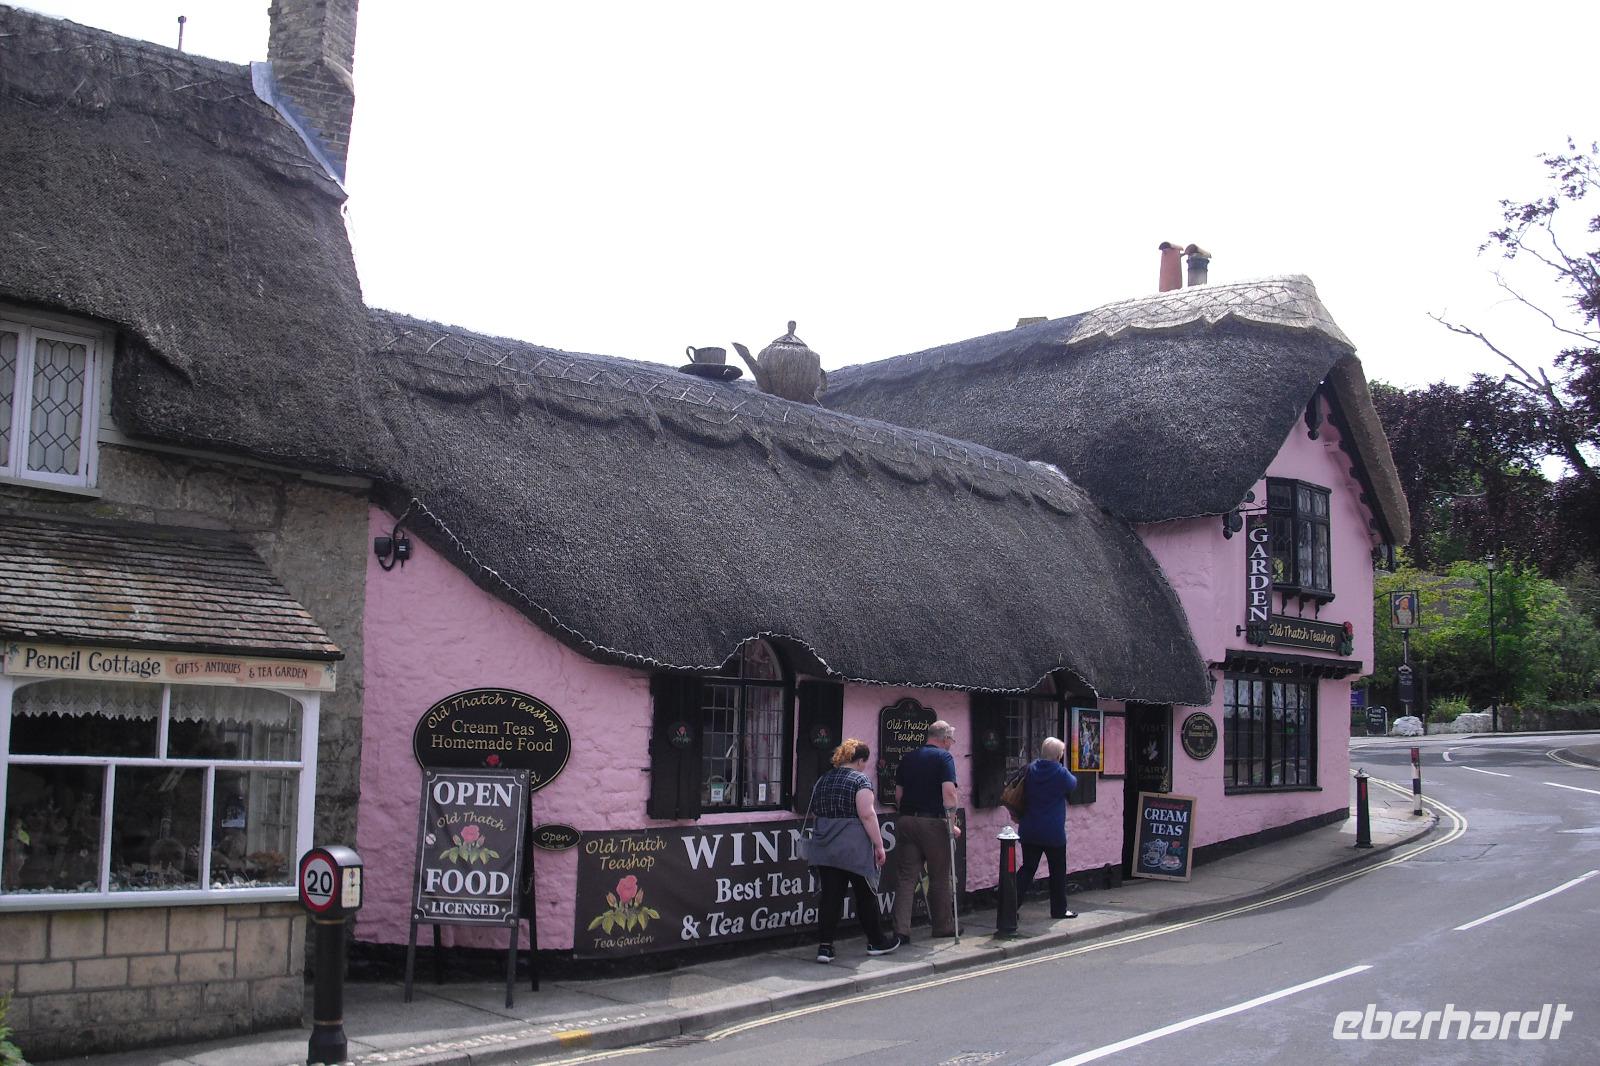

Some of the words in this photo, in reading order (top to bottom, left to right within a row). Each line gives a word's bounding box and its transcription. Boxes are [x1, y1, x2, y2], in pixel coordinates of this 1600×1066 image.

[1249, 527, 1269, 622] GARDEN
[1284, 625, 1309, 640] Thatch
[1309, 629, 1336, 647] Teashop
[25, 647, 81, 671] Pencil
[88, 651, 161, 678] Cottage
[175, 662, 200, 675] GIFTS
[205, 661, 241, 674] ANTIQUES
[1269, 666, 1293, 677] Open
[257, 667, 272, 677] TEA
[274, 666, 308, 679] GARDEN
[427, 705, 451, 729] Old
[452, 693, 507, 712] Thatch
[511, 696, 559, 734] Teashop
[451, 720, 499, 735] Cream
[503, 721, 535, 736] Teas
[887, 718, 902, 730] Old
[431, 734, 513, 751] Homemade
[517, 737, 554, 752] Food
[893, 731, 925, 745] Teashop
[433, 781, 515, 807] OPEN
[436, 812, 461, 828] Old
[462, 811, 507, 831] Thatch
[1144, 808, 1188, 823] CREAM
[541, 832, 571, 844] Open
[1150, 823, 1184, 836] TEAS
[585, 838, 618, 854] Old
[620, 836, 667, 853] Thatch
[599, 854, 655, 873] Teashop
[307, 870, 332, 893] 20
[425, 868, 510, 896] FOOD
[715, 876, 762, 904] Best
[767, 871, 803, 896] Tea
[431, 901, 500, 916] LICENSED
[680, 915, 701, 941] &
[706, 910, 745, 937] Tea
[594, 937, 615, 949] Tea
[616, 933, 654, 947] Garden
